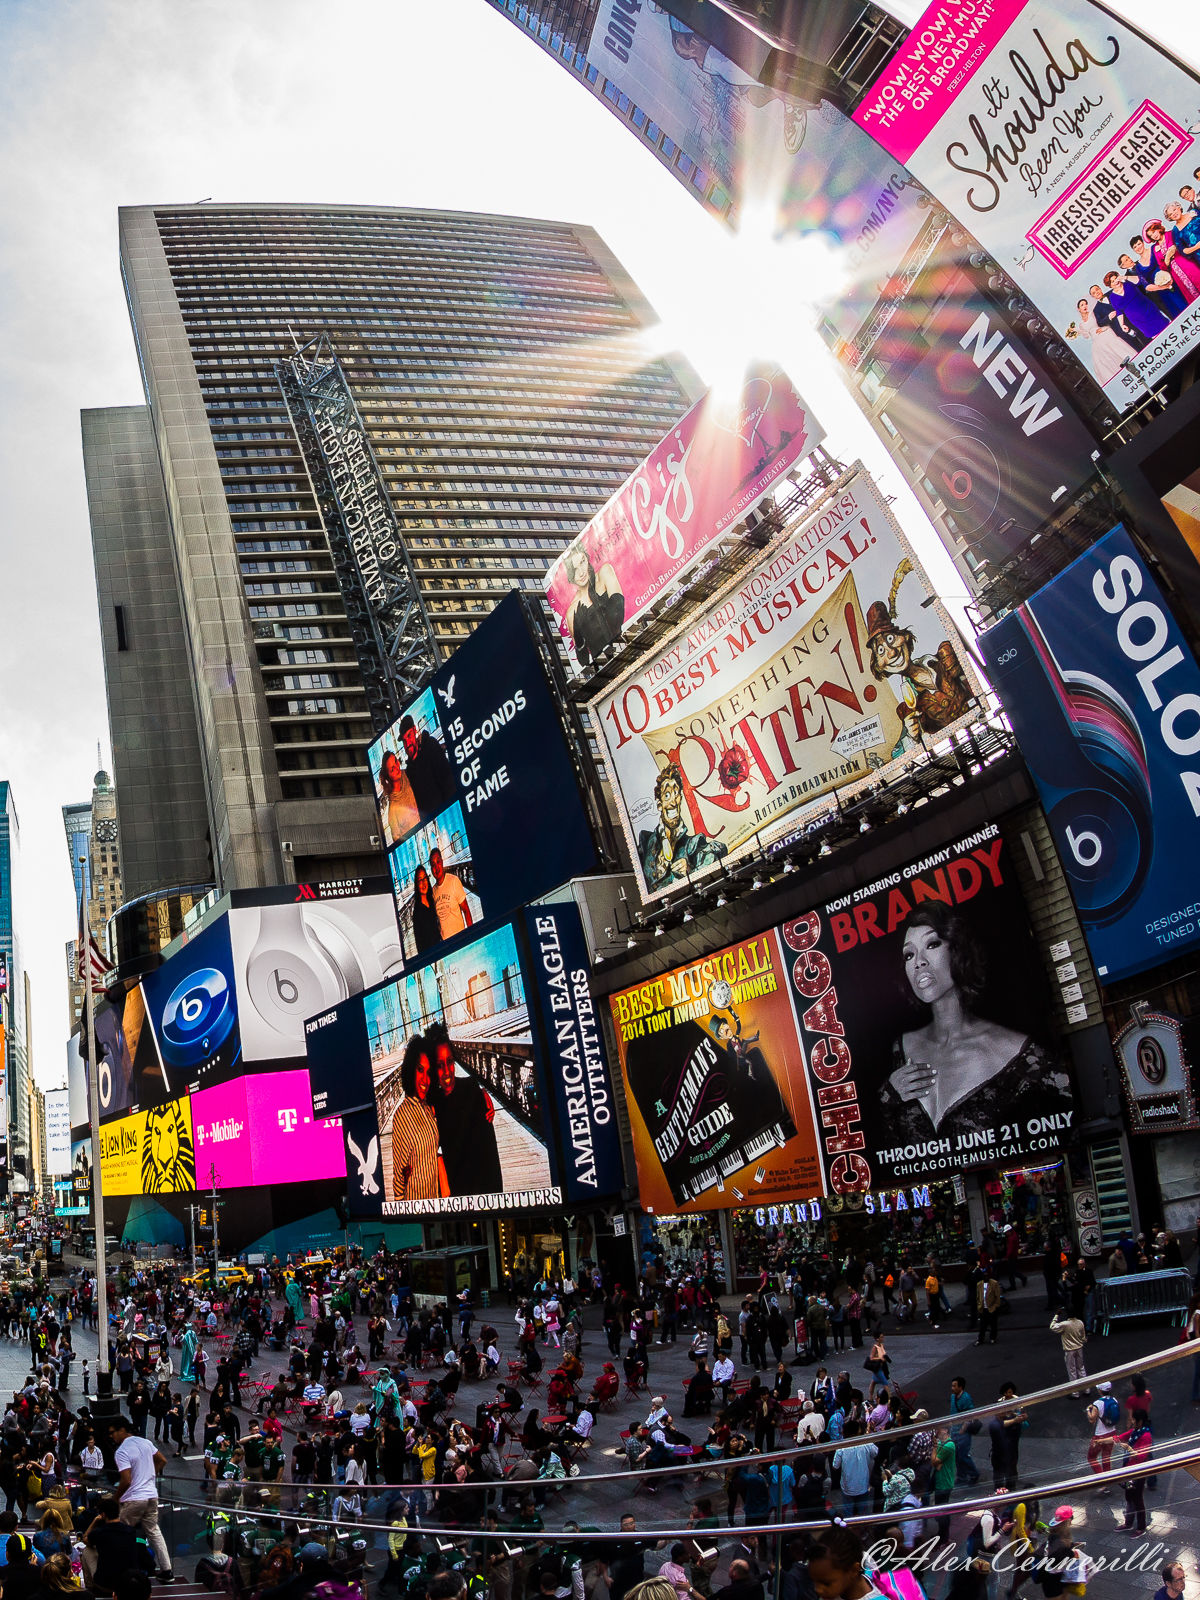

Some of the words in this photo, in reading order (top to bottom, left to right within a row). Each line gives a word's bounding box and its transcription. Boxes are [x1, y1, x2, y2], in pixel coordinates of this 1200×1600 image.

[908, 8, 952, 62] WOW!
[946, 70, 966, 93] PEREZ
[963, 42, 986, 72] HILTON
[878, 98, 906, 128] THE
[901, 63, 930, 100] BEST
[928, 27, 956, 64] NEW
[912, 86, 934, 110] ON
[982, 76, 1010, 118] It
[946, 28, 1120, 212] Shoulda
[1020, 136, 1068, 198] Been
[1053, 95, 1103, 140] You
[1050, 170, 1065, 188] NEW
[1065, 142, 1091, 171] MUSICAL
[1090, 112, 1114, 142] COMEDY
[1044, 158, 1125, 247] IRRESISTIBLE
[1120, 116, 1160, 160] CAST!
[1056, 174, 1136, 260] IRRESISTIBLE
[1130, 130, 1174, 178] PRICE!
[958, 312, 1064, 437] NEW
[1148, 349, 1176, 377] AROUND
[1176, 336, 1190, 350] THE
[316, 416, 349, 481] EAGLE
[342, 428, 396, 561] OUTFITTERS
[632, 429, 696, 559] Gigi
[738, 486, 759, 510] SIMON
[758, 456, 788, 490] THEATRE
[337, 479, 387, 603] AMERICAN
[606, 684, 650, 749] 10
[645, 646, 680, 686] TONY
[686, 602, 737, 656] AWARD
[739, 492, 858, 607] NOMINATIONS!
[652, 648, 720, 718] BEST
[724, 518, 877, 660] MUSICAL!
[729, 591, 772, 630] INCLUDING
[674, 618, 830, 745] SOMETHING
[997, 646, 1018, 666] solo
[447, 717, 465, 742] 15
[454, 689, 526, 765] SECONDS
[460, 758, 482, 786] OF
[466, 764, 511, 812] FAME
[319, 878, 363, 890] MARRIOTT
[320, 888, 360, 897] MARQUIS
[826, 895, 852, 914] NOW
[853, 873, 901, 902] STARRING
[902, 848, 952, 878] GRAMMY
[953, 824, 1000, 854] WINNER
[830, 838, 1004, 954] BRANDY
[535, 916, 572, 1012] EAGLE
[617, 989, 668, 1024] BEST
[670, 938, 772, 1000] MUSICAL!
[306, 1020, 318, 1034] FUN
[318, 1011, 338, 1028] TIMES!
[622, 1022, 644, 1042] 2014
[646, 1014, 672, 1035] TONY
[674, 999, 710, 1030] AWARD
[732, 974, 778, 1006] WINNER
[571, 968, 610, 1124] OUTFITTERS
[782, 910, 872, 1196] CHICAGO
[556, 1019, 598, 1188] AMERICAN
[654, 1100, 668, 1117] A
[655, 1038, 720, 1162] GENTLEMAN'S
[687, 1102, 734, 1146] GUIDE
[1142, 1102, 1178, 1117] radioshack
[120, 1126, 138, 1156] KING
[876, 1138, 950, 1164] THROUGH
[952, 1129, 996, 1152] JUNE
[1000, 1122, 1020, 1143] 21
[1024, 1111, 1074, 1136] ONLY
[893, 1135, 1061, 1176] CHICAGOTHEMUSICAL.COM
[382, 1199, 434, 1216] AMERICAN
[439, 1195, 474, 1213] EAGLE
[477, 1188, 561, 1210] OUTFITTERS
[755, 1200, 822, 1227] GRAND
[864, 1184, 932, 1214] SLAM
